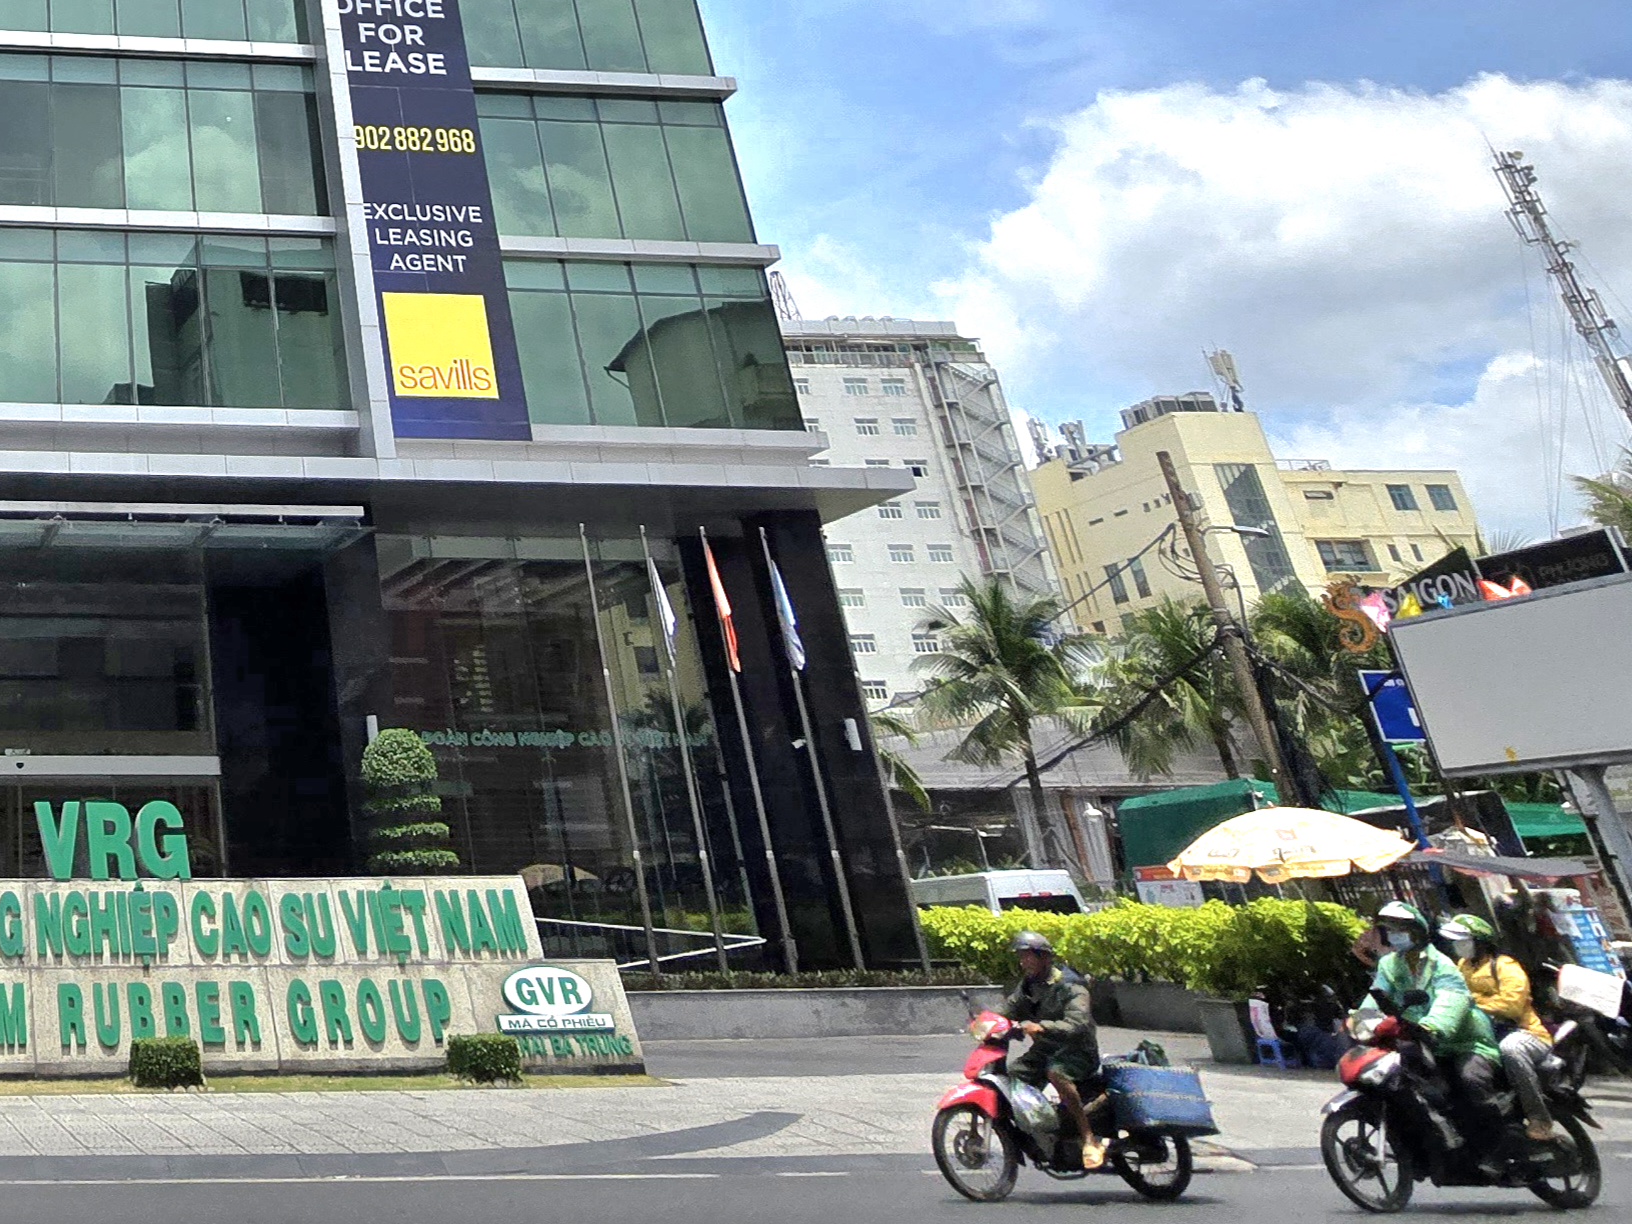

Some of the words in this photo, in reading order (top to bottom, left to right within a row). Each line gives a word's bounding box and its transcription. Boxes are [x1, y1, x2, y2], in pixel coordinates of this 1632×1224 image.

[358, 22, 426, 46] FOR
[345, 50, 447, 75] LEASE
[394, 127, 434, 152] 882
[435, 128, 476, 153] 968
[363, 203, 483, 223] EXCLUSIVE
[375, 228, 474, 247] LEASING
[390, 253, 467, 272] AGENT
[399, 359, 492, 391] savills
[34, 800, 192, 882] VRG
[34, 880, 180, 971] NGHIỆP
[191, 890, 269, 956] CAO
[279, 892, 336, 957] SU
[338, 879, 429, 966] VIỆT
[434, 889, 528, 954] NAM
[515, 977, 583, 1005] GVR
[57, 979, 261, 1048] RUBBER
[286, 978, 451, 1044] GROUP
